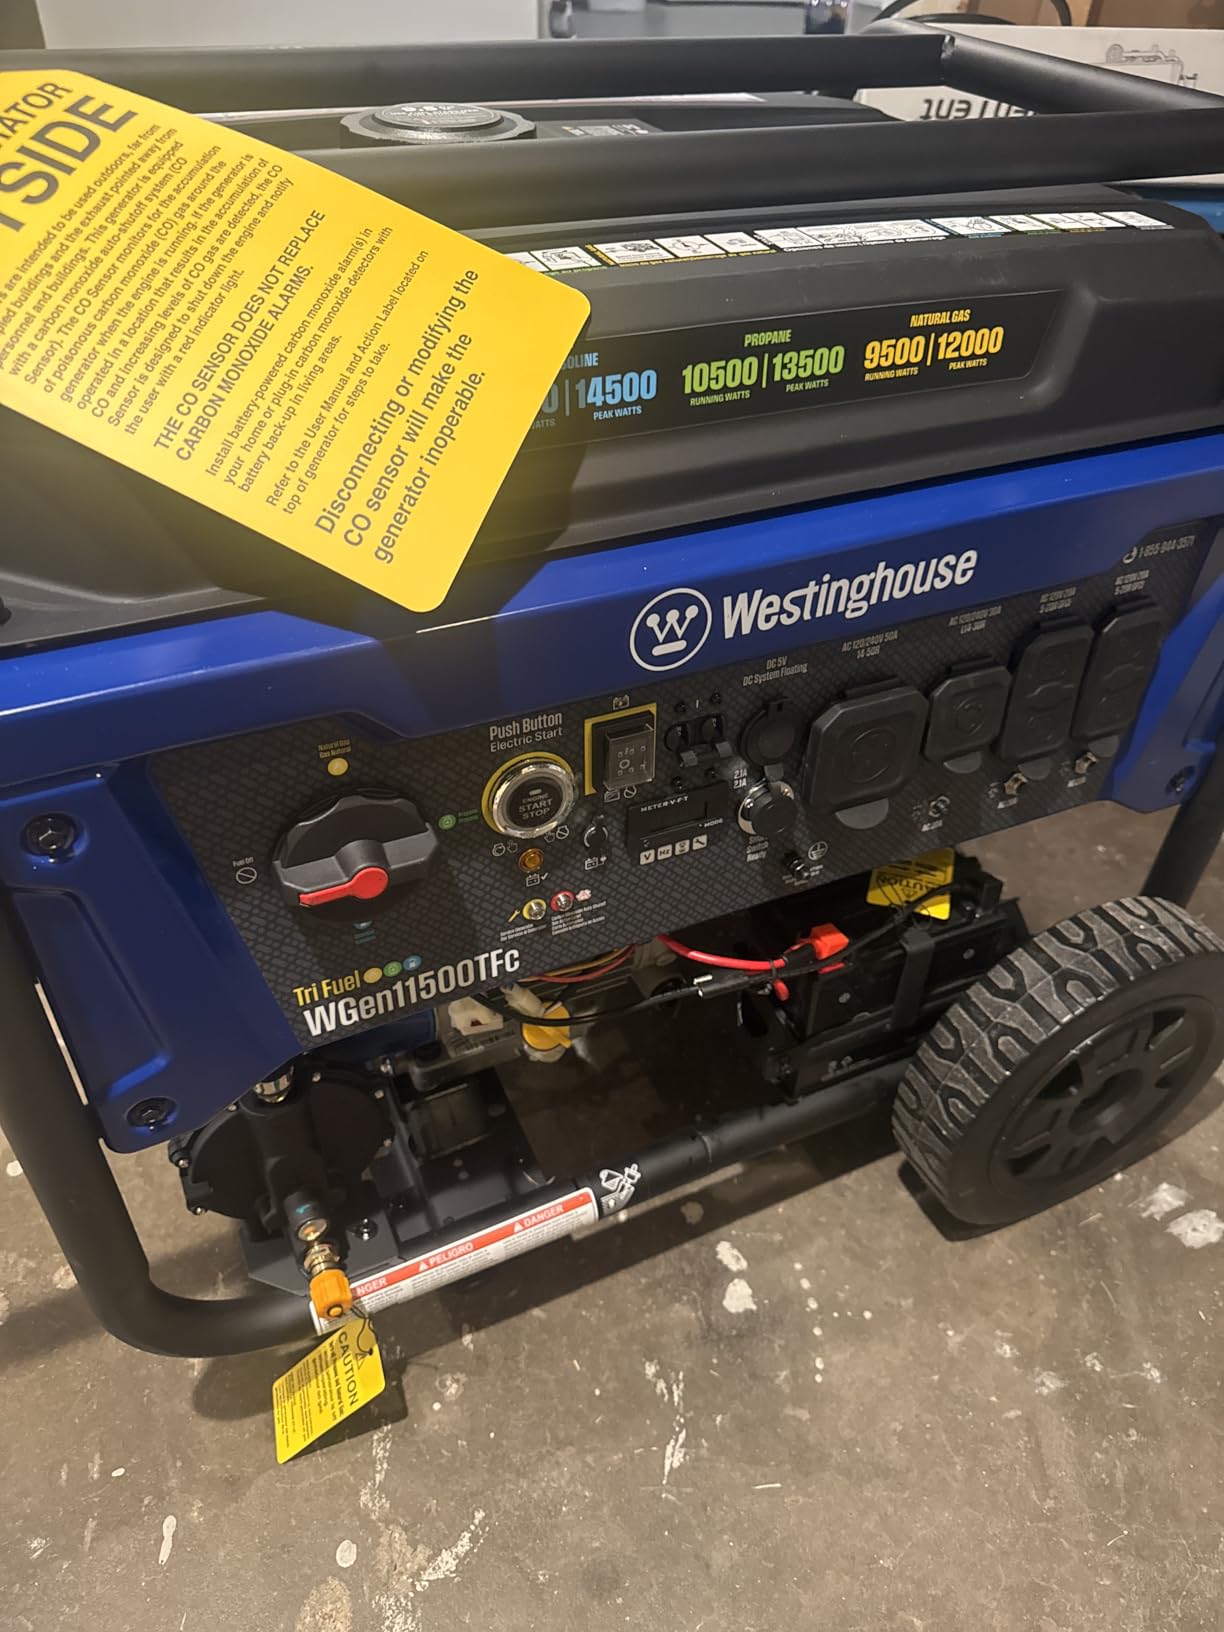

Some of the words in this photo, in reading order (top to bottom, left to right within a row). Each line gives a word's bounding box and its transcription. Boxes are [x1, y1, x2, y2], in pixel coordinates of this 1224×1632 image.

[8, 351, 31, 375] with
[26, 341, 38, 351] a
[33, 304, 66, 341] carbon
[61, 255, 103, 304] monoxide
[99, 200, 148, 256] auto-shutoff
[144, 172, 174, 202] system
[168, 156, 187, 174] (CO
[24, 339, 64, 384] Sensor).
[56, 315, 79, 336] The
[72, 297, 92, 315] CO
[86, 262, 119, 298] Sensor
[115, 222, 152, 264] monitors
[146, 207, 164, 222] for
[157, 193, 176, 208] the
[172, 145, 221, 195] accumulation
[107, 384, 140, 426] Sensor
[133, 372, 149, 385] is
[144, 322, 182, 372] designed
[176, 312, 190, 324] to
[186, 289, 208, 313] shut
[202, 263, 227, 290] down
[220, 247, 238, 263] the
[234, 217, 261, 247] engine
[257, 199, 274, 218] and
[269, 177, 294, 201] notify
[910, 312, 950, 328] NATURAL
[951, 309, 971, 323] GAS
[153, 416, 184, 448] THE
[175, 392, 198, 416] CO
[191, 332, 240, 391] SENSOR
[230, 293, 265, 333] DOES
[256, 264, 284, 295] NOT
[276, 209, 325, 267] REPLACE
[744, 329, 792, 347] PROPANE
[124, 414, 143, 435] the
[138, 386, 160, 414] user
[155, 363, 177, 387] with
[172, 354, 183, 363] a
[178, 334, 196, 354] red
[188, 291, 226, 336] indicator
[219, 269, 244, 293] light.
[175, 392, 226, 460] CARBON
[216, 317, 275, 394] MONOXIDE
[266, 265, 314, 321] ALARMS.
[205, 438, 234, 476] Install
[226, 352, 288, 439] battery-powered
[283, 319, 311, 354] carbon
[306, 273, 341, 319] monoxide
[337, 236, 368, 273] alarm(s)
[359, 228, 373, 237] in
[223, 455, 245, 485] your
[239, 419, 267, 452] home
[262, 404, 275, 419] or
[269, 368, 299, 407] plug-in
[294, 332, 322, 368] carbon
[317, 286, 352, 333] monoxide
[347, 244, 380, 286] detectors
[375, 227, 393, 244] with
[863, 335, 926, 370] 9500
[937, 326, 1004, 360] 12000
[948, 360, 967, 371] PEAK
[967, 358, 987, 369] WATTS
[265, 472, 291, 506] Refer
[284, 460, 299, 473] to
[292, 439, 311, 459] the
[303, 411, 327, 438] User
[319, 372, 350, 412] Manual
[345, 352, 363, 374] and
[356, 322, 383, 355] Action
[375, 294, 399, 322] Label
[392, 261, 420, 296] located
[416, 250, 428, 262] on
[681, 355, 759, 394] 10500
[772, 345, 846, 381] 13500
[785, 382, 803, 393] PEAK
[803, 378, 829, 390] WATTS
[864, 370, 893, 382] RUNNING
[893, 367, 919, 378] WATTS
[314, 398, 405, 534] Disconnecting
[395, 375, 414, 397] or
[407, 295, 466, 376] modifying
[452, 270, 478, 294] the
[575, 369, 657, 409] 14500
[689, 394, 723, 407] RUNNING
[724, 390, 751, 403] WATTS
[237, 450, 270, 492] battery
[261, 405, 296, 450] back-up
[288, 393, 304, 405] in
[296, 363, 324, 393] living
[317, 335, 342, 364] areas.
[282, 493, 301, 514] top
[296, 477, 309, 492] of
[304, 423, 340, 480] generator
[333, 406, 350, 424] for
[345, 378, 367, 407] steps
[360, 366, 374, 378] to
[368, 343, 390, 365] take.
[593, 408, 614, 420] PEAK
[614, 405, 642, 418] WATTS
[343, 513, 371, 546] CO
[365, 444, 408, 512] sensor
[400, 408, 428, 443] will
[420, 362, 455, 411] make
[445, 334, 472, 360] the
[374, 465, 430, 564] generator
[419, 372, 485, 466] inoperable.
[722, 549, 977, 639] Westinghouse
[767, 658, 776, 669] DC
[777, 655, 788, 667] 5V
[842, 641, 852, 652] AC
[853, 634, 883, 650] 120/240V
[743, 675, 753, 686] DC
[754, 668, 780, 684] System
[780, 662, 808, 678] Floating
[490, 718, 520, 739] Push
[522, 712, 562, 734] Button
[490, 735, 533, 753] Electric
[535, 727, 563, 742] Start
[518, 799, 553, 813] START
[522, 808, 550, 819] STOP
[704, 818, 724, 828] MODE
[232, 859, 244, 867] Fuel
[245, 856, 255, 865] Off
[659, 849, 670, 857] Hz
[292, 984, 320, 1007] Tri
[321, 969, 361, 999] Fuel
[303, 948, 520, 1036] WGen11500TFc
[524, 1204, 564, 1227] DANGER
[429, 1242, 474, 1266] PELIGRO
[356, 1278, 388, 1296] NGER
[338, 1331, 359, 1407] CAUTION
